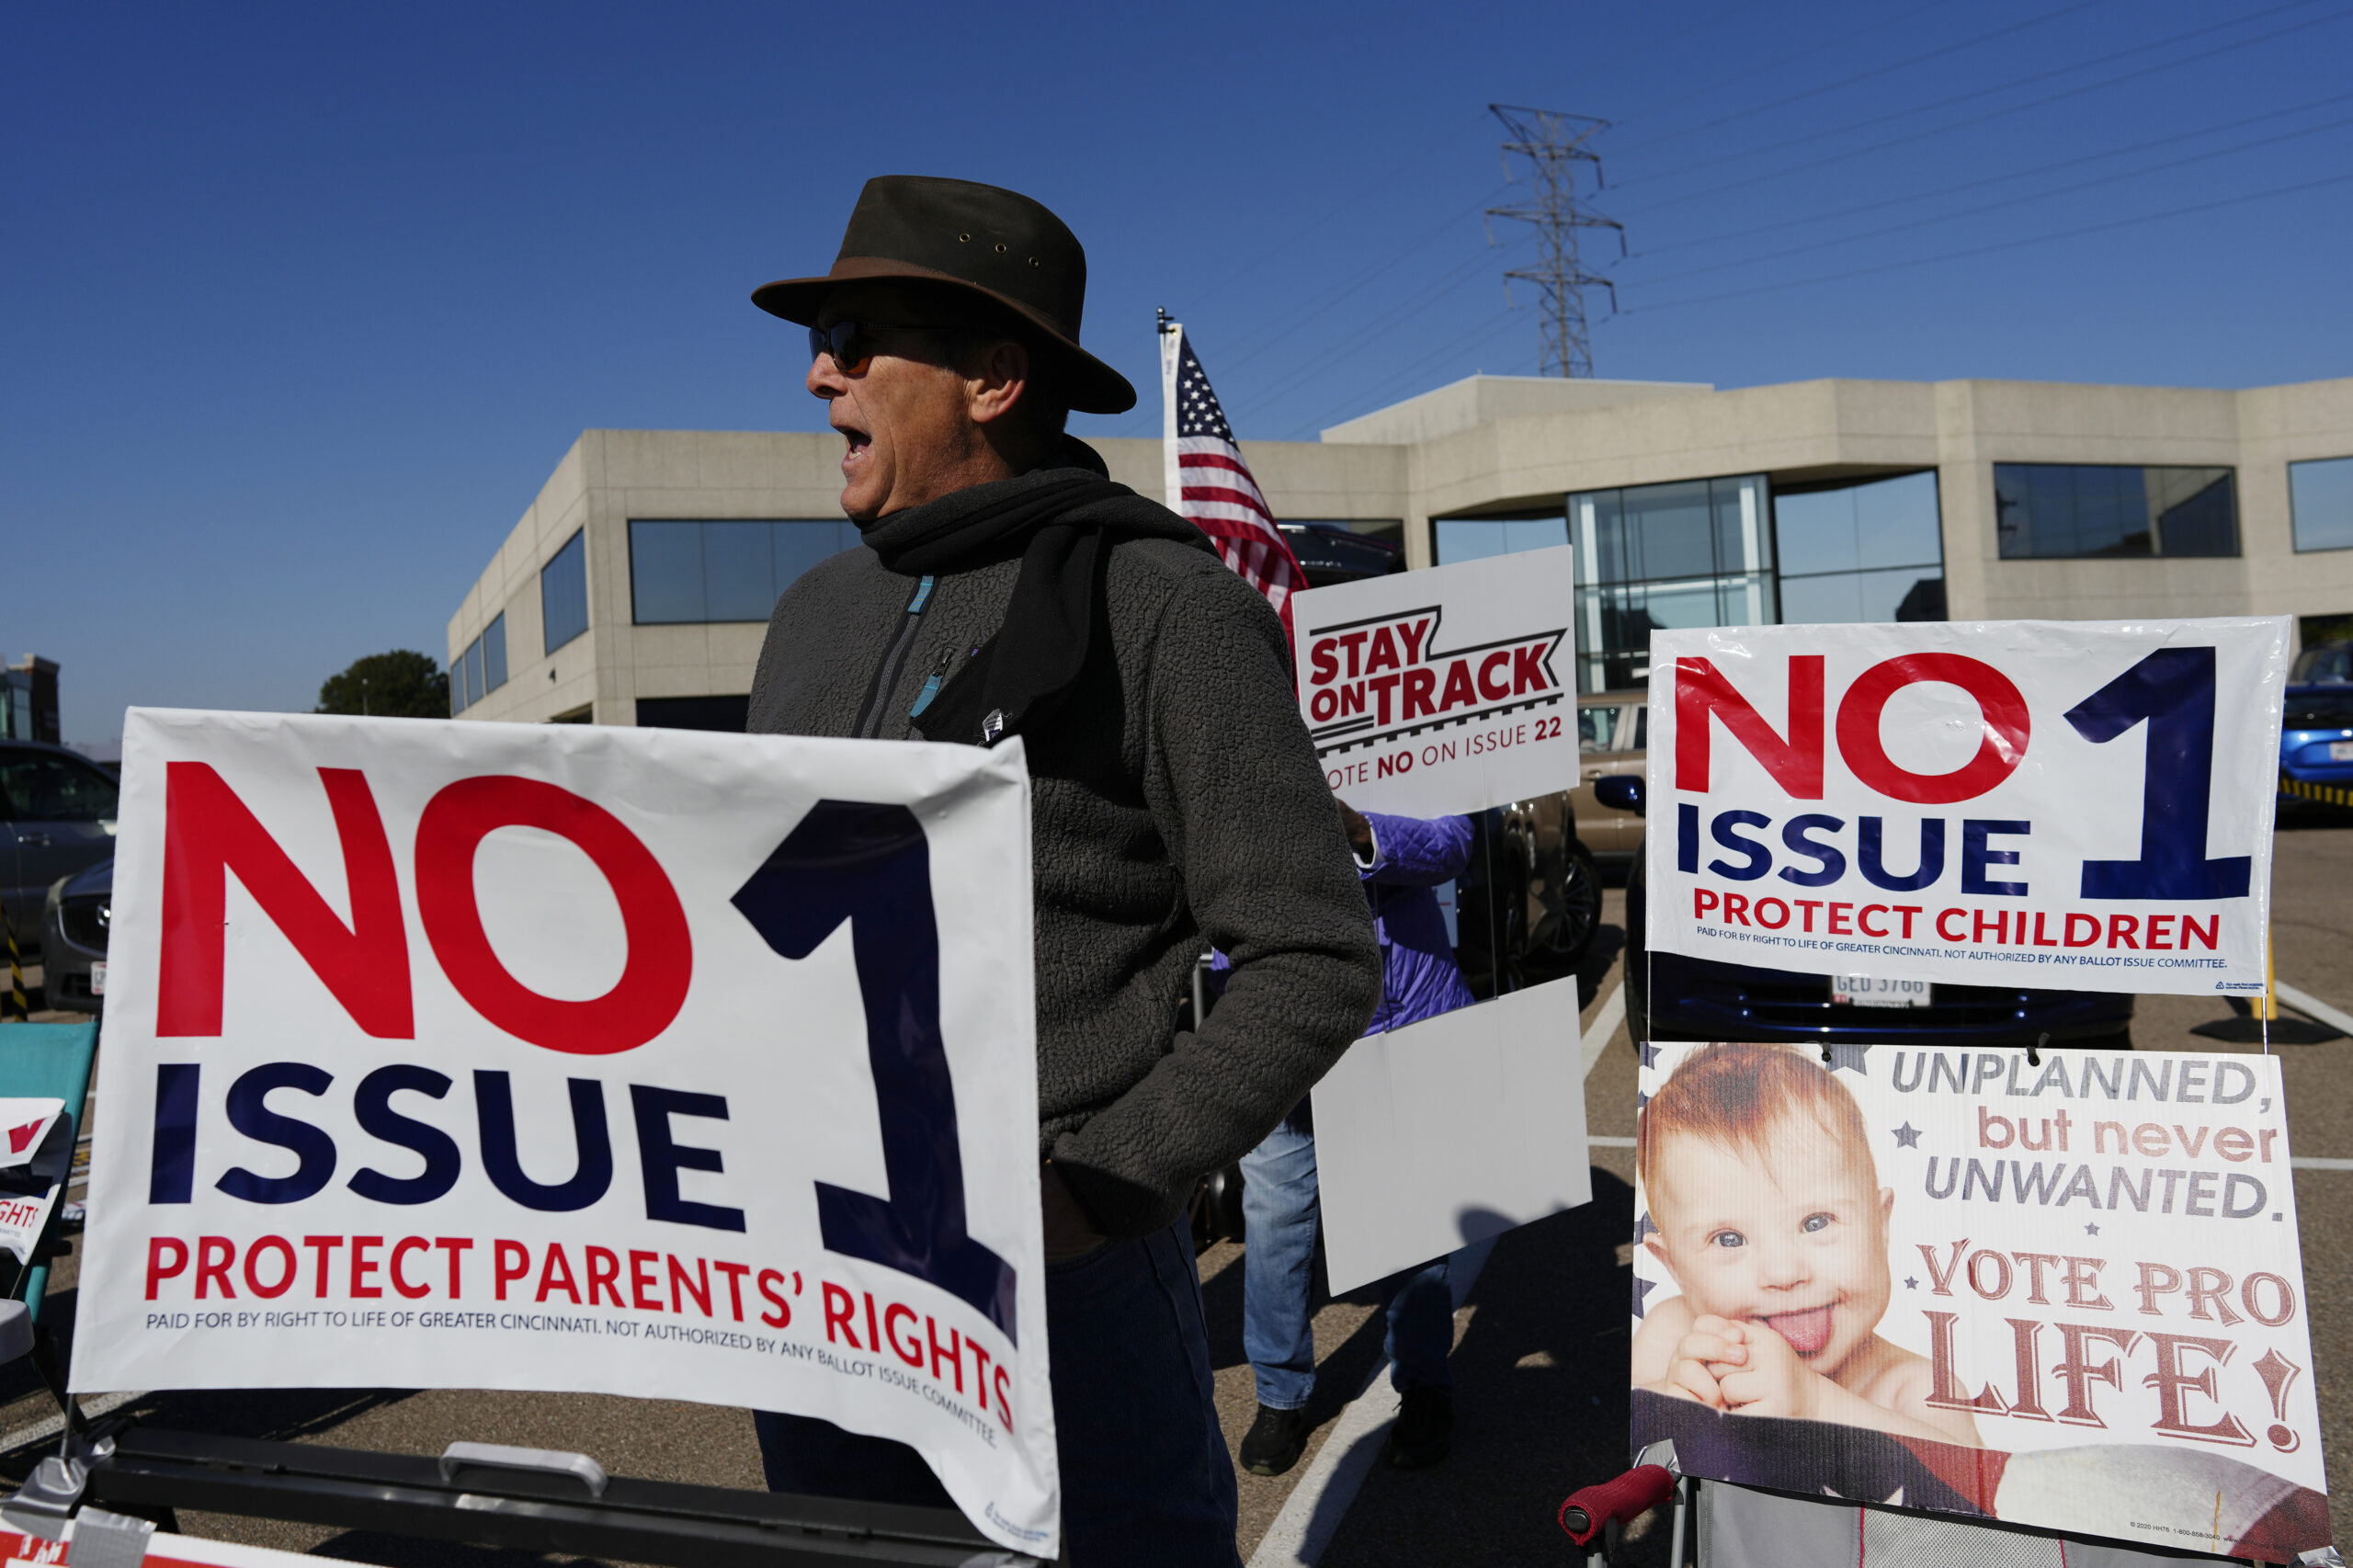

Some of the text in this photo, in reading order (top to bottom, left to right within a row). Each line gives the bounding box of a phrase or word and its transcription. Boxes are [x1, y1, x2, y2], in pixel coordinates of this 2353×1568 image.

[1310, 618, 1430, 686] STAY
[1311, 642, 1550, 727] ON TRACK
[1327, 716, 1562, 791] OTE NO ON ISSUE 22
[1676, 652, 2030, 804] NO
[2063, 646, 2252, 900] 1
[1677, 802, 2031, 897] ISSUE
[155, 761, 693, 1055] NO
[1694, 888, 2221, 951] PROTECT CHILDREN
[1697, 926, 2228, 968] PAID FOR BY RIGHT TO LIFE OF GREATER CINCINNATI. NOT AUTHORIZED BY ANY BALLOT ISSUE COMMITTEE.
[729, 799, 1017, 1353] 1
[1892, 1051, 2272, 1114] UNPLANNED,
[149, 1062, 746, 1233] ISSUE
[1978, 1106, 2278, 1164] but never
[0, 1201, 39, 1229] GHTS
[1925, 1155, 2283, 1222] UNWANTED.
[1915, 1237, 2296, 1327] VOTE PRO
[145, 1234, 1014, 1435] PROTECT PARENTS' RIGHTS
[146, 1312, 997, 1449] PAID FOR BY RIGHT TO LIFE OF GREATER CINCINNATI. NOT AUTHORIZED BY ANY BALLOT ISSUE COMMITTEE.
[1920, 1310, 2302, 1454] LIFE!
[2137, 1522, 2152, 1530] 2020
